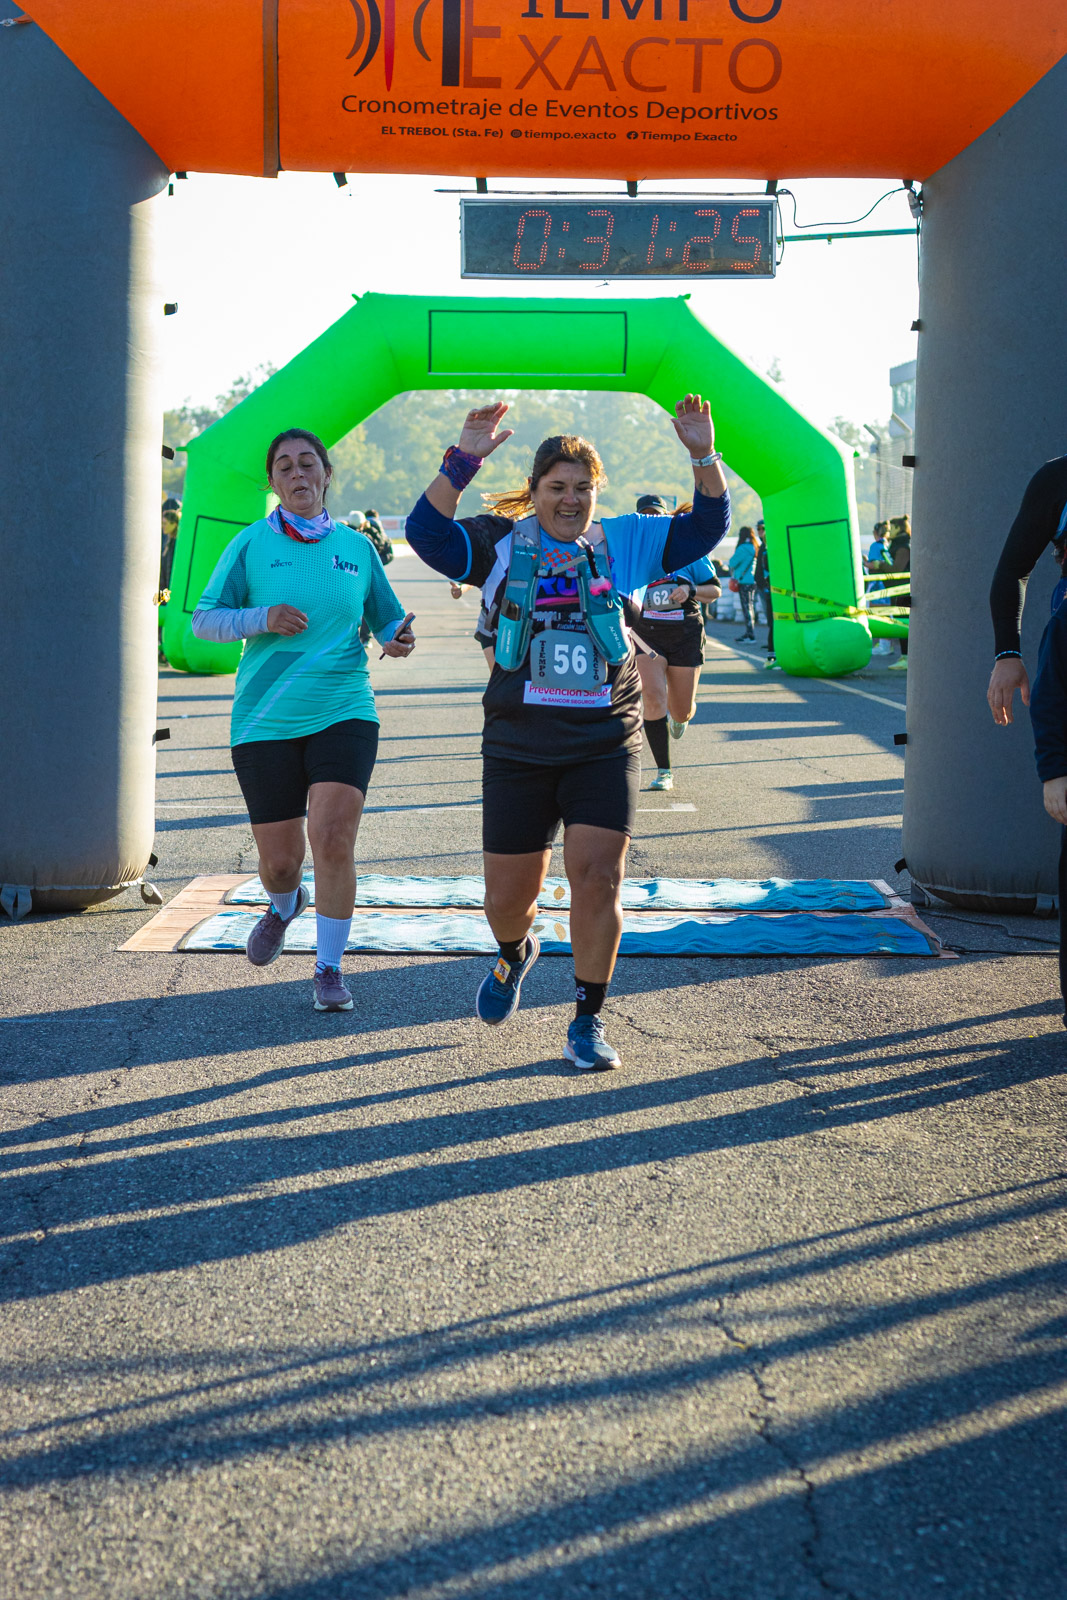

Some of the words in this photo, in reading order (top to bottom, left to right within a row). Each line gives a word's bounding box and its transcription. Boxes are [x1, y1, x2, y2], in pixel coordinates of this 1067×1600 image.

[341, 95, 502, 120] Cronometraje
[508, 98, 538, 117] de
[545, 99, 639, 119] Eventos
[646, 101, 779, 124] Deportivos
[381, 126, 397, 135] EL
[398, 126, 450, 137] TREBOL
[452, 127, 481, 138] (Sta.
[484, 128, 503, 139] Fe)
[524, 130, 617, 141] tiempo.exacto
[640, 131, 691, 142] Tiempo
[694, 132, 738, 142] Exacto
[512, 208, 762, 271] 0:31:25
[652, 590, 670, 606] 62
[538, 640, 547, 678] TIEMPO
[553, 643, 588, 675] 56
